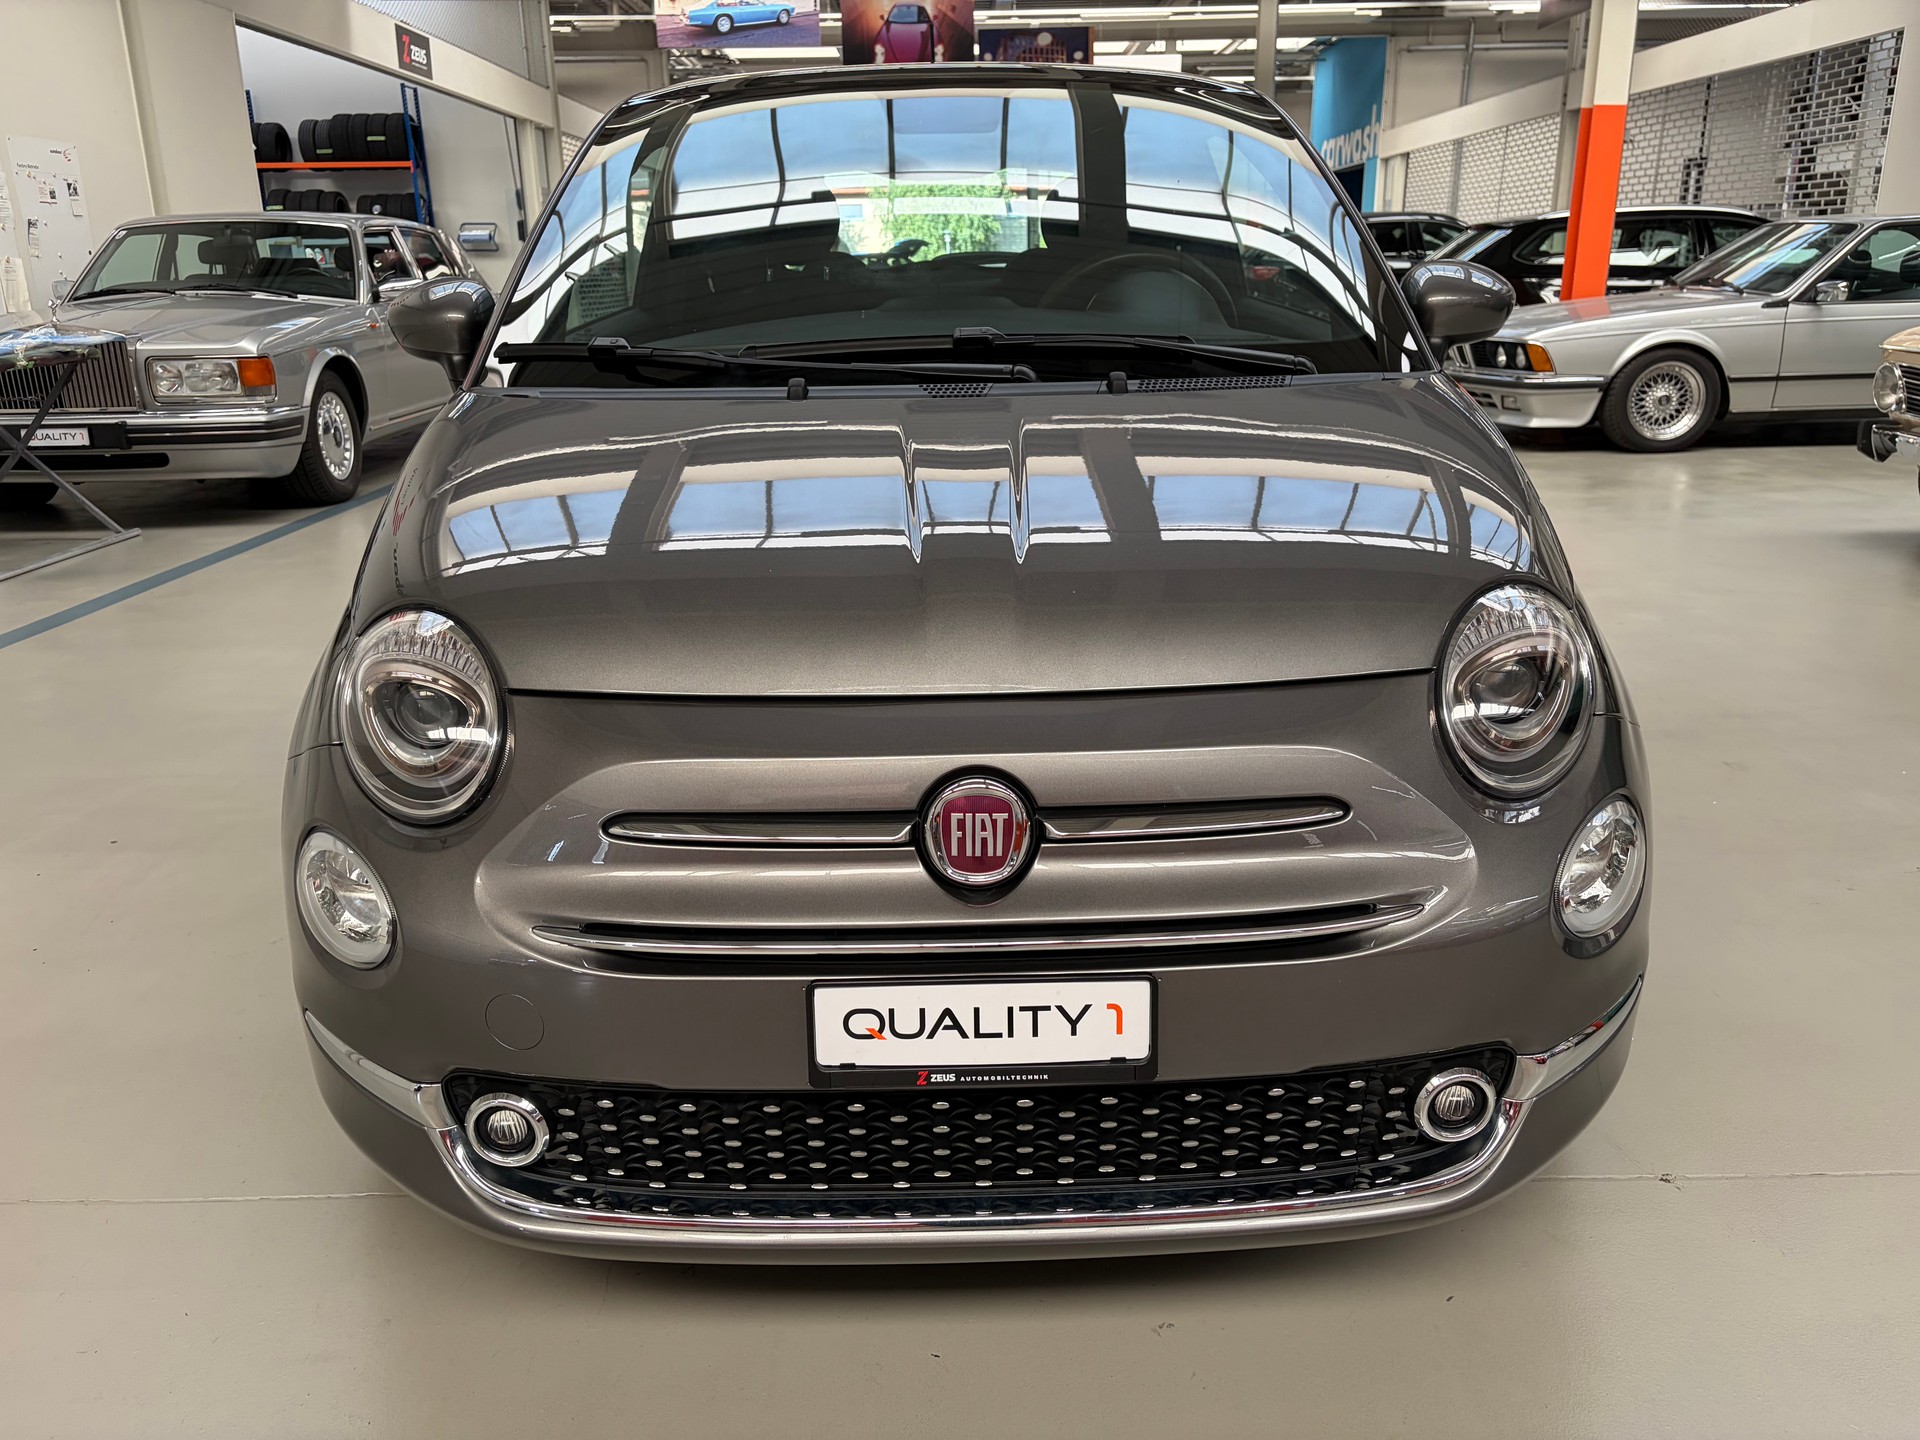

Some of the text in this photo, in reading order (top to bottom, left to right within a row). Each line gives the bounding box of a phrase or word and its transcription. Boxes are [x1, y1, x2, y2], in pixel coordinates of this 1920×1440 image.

[410, 45, 428, 64] ZEUS
[1320, 104, 1380, 168] carwash
[950, 812, 1008, 857] FIAT
[842, 1003, 1123, 1040] QUALITY 1
[930, 1073, 956, 1082] ZEUS
[960, 1074, 1049, 1082] AUTOMOBILTECHNIK
